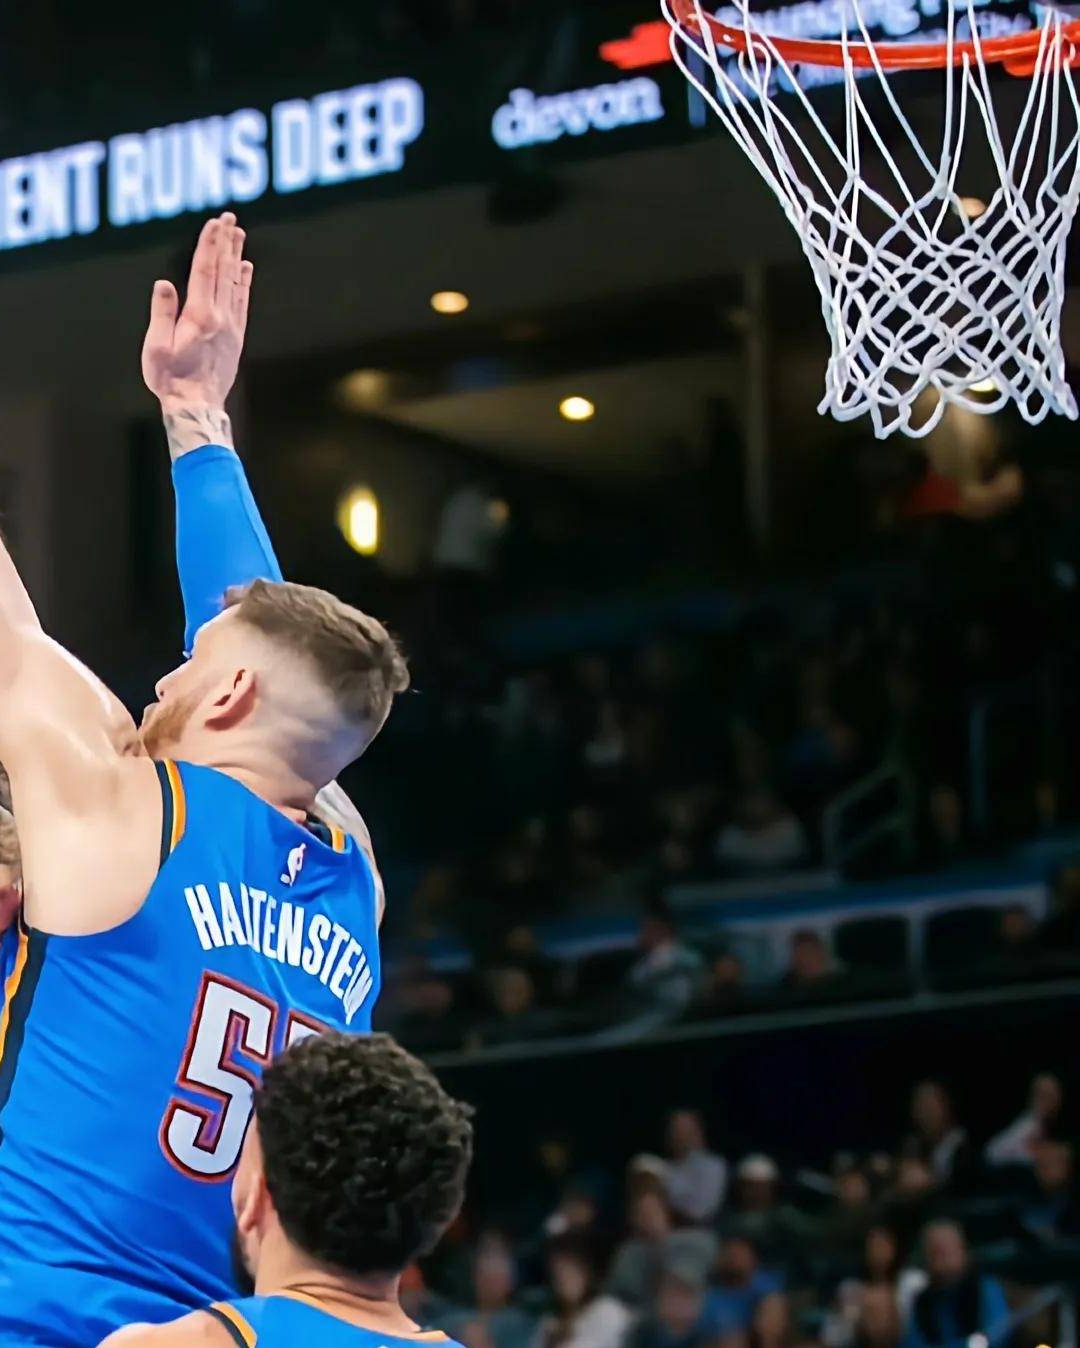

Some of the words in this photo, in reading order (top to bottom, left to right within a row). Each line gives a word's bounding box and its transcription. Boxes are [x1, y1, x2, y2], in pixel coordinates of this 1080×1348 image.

[108, 107, 268, 227] RUNS
[272, 76, 424, 192] DEEP
[491, 78, 665, 149] devon
[158, 969, 342, 1184] 5
